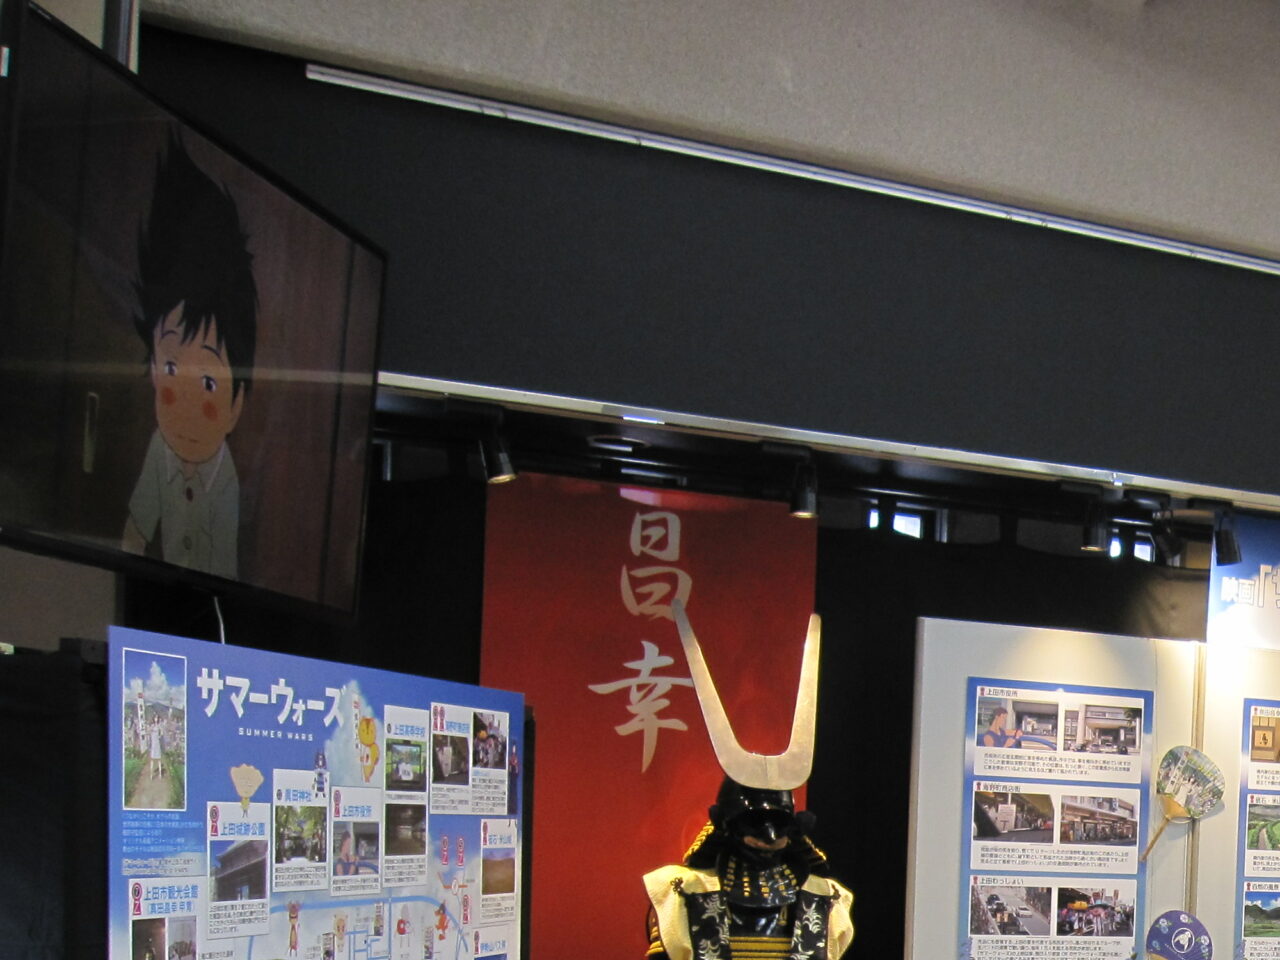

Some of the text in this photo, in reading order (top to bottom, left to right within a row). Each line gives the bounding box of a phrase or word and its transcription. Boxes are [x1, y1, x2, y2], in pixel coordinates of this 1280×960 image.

[197, 667, 349, 727] サマーウォーズ
[238, 727, 314, 742] SUMMER WARS
